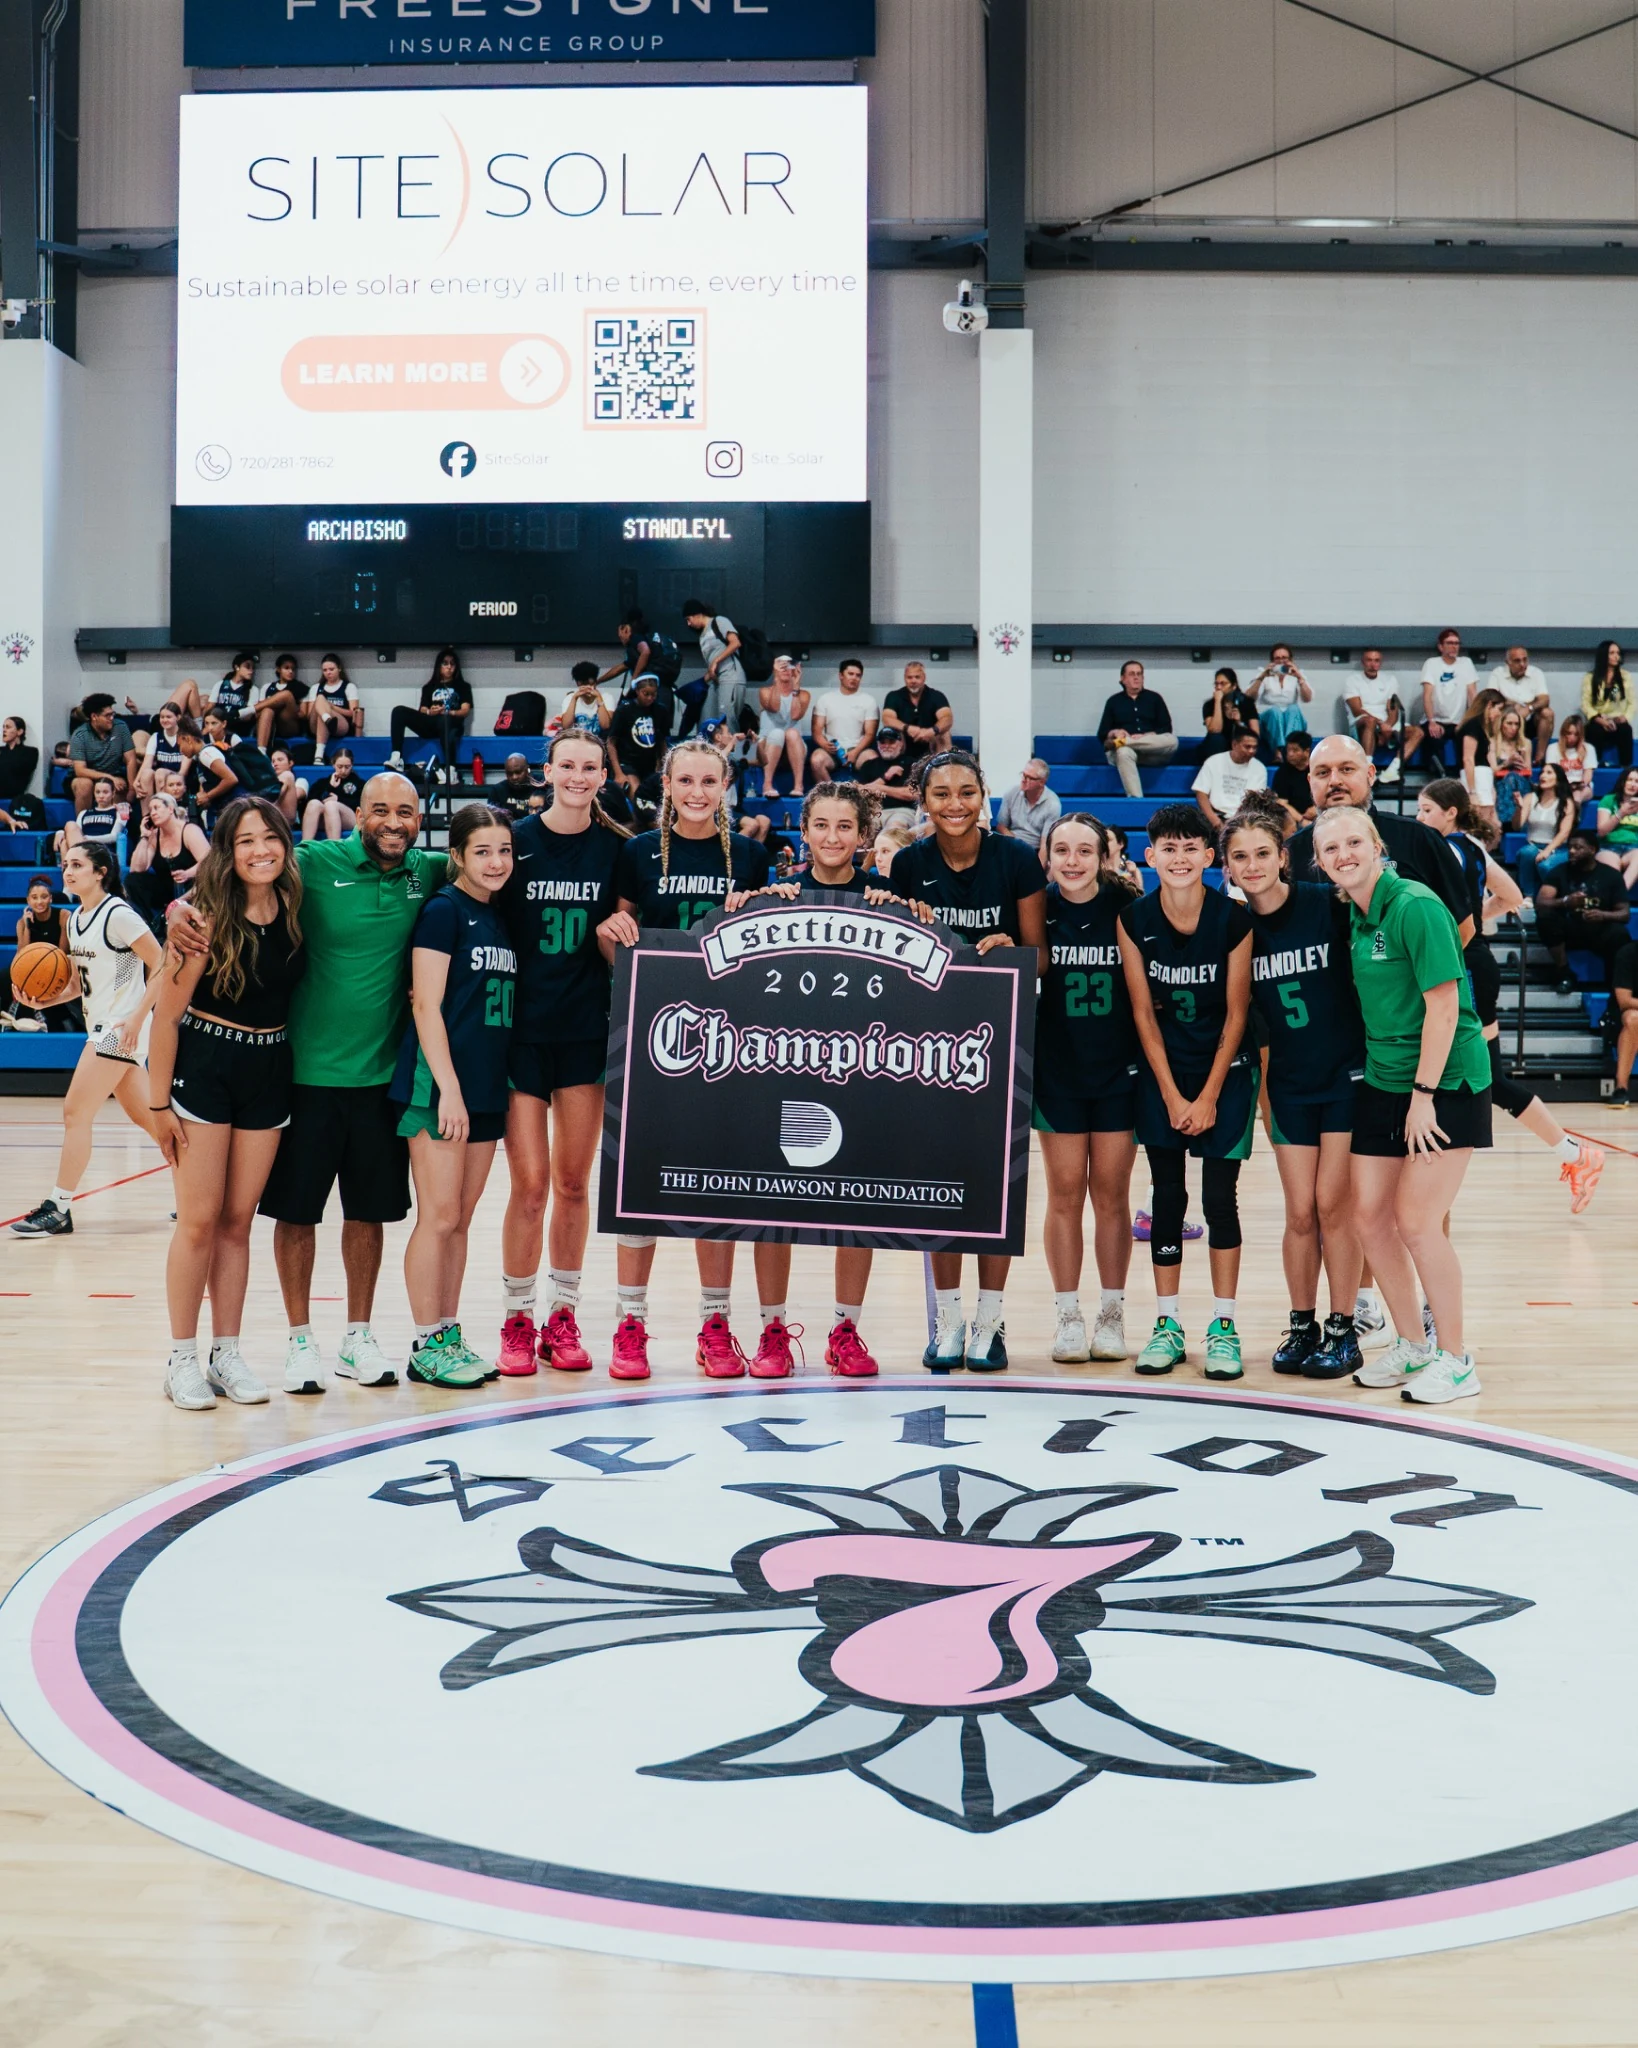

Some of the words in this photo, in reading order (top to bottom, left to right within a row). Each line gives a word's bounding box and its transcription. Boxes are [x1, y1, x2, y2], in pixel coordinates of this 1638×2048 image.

[390, 36, 552, 53] INSURANCE
[569, 35, 664, 51] GROUP
[246, 154, 441, 222] SITE
[485, 152, 796, 218] SOLAR
[188, 276, 347, 298] Sustainable
[356, 274, 420, 295] solar
[430, 276, 527, 299] energy
[535, 271, 565, 293] all
[575, 271, 620, 293] the
[628, 270, 700, 295] time,
[708, 275, 784, 297] every
[791, 269, 858, 292] time
[299, 363, 394, 384] LEARN
[405, 361, 488, 382] MORE
[240, 455, 335, 470] 720/281-7862
[484, 452, 550, 466] SiteSolar
[307, 519, 408, 541] ARCHBISHO
[623, 517, 732, 541] STANDLEYL
[469, 601, 518, 617] PERIOD
[526, 880, 601, 901] STANDLEY
[657, 875, 736, 895] STANDLEY
[539, 907, 588, 955] 30
[932, 906, 1001, 928] STANDLEY
[471, 946, 518, 974] STANDL
[1149, 960, 1218, 985] STANDLEY
[1250, 943, 1330, 982] TANDLEY
[764, 969, 884, 998] 2026
[1064, 971, 1113, 1017] 23
[484, 978, 515, 1028] 20
[1171, 990, 1197, 1023] 3
[1276, 981, 1310, 1029] 5
[652, 1006, 990, 1086] Champions
[660, 1172, 698, 1189] THE
[701, 1174, 751, 1193] JOHN
[756, 1177, 836, 1197] DAWSON
[839, 1182, 965, 1204] FOUNDATION
